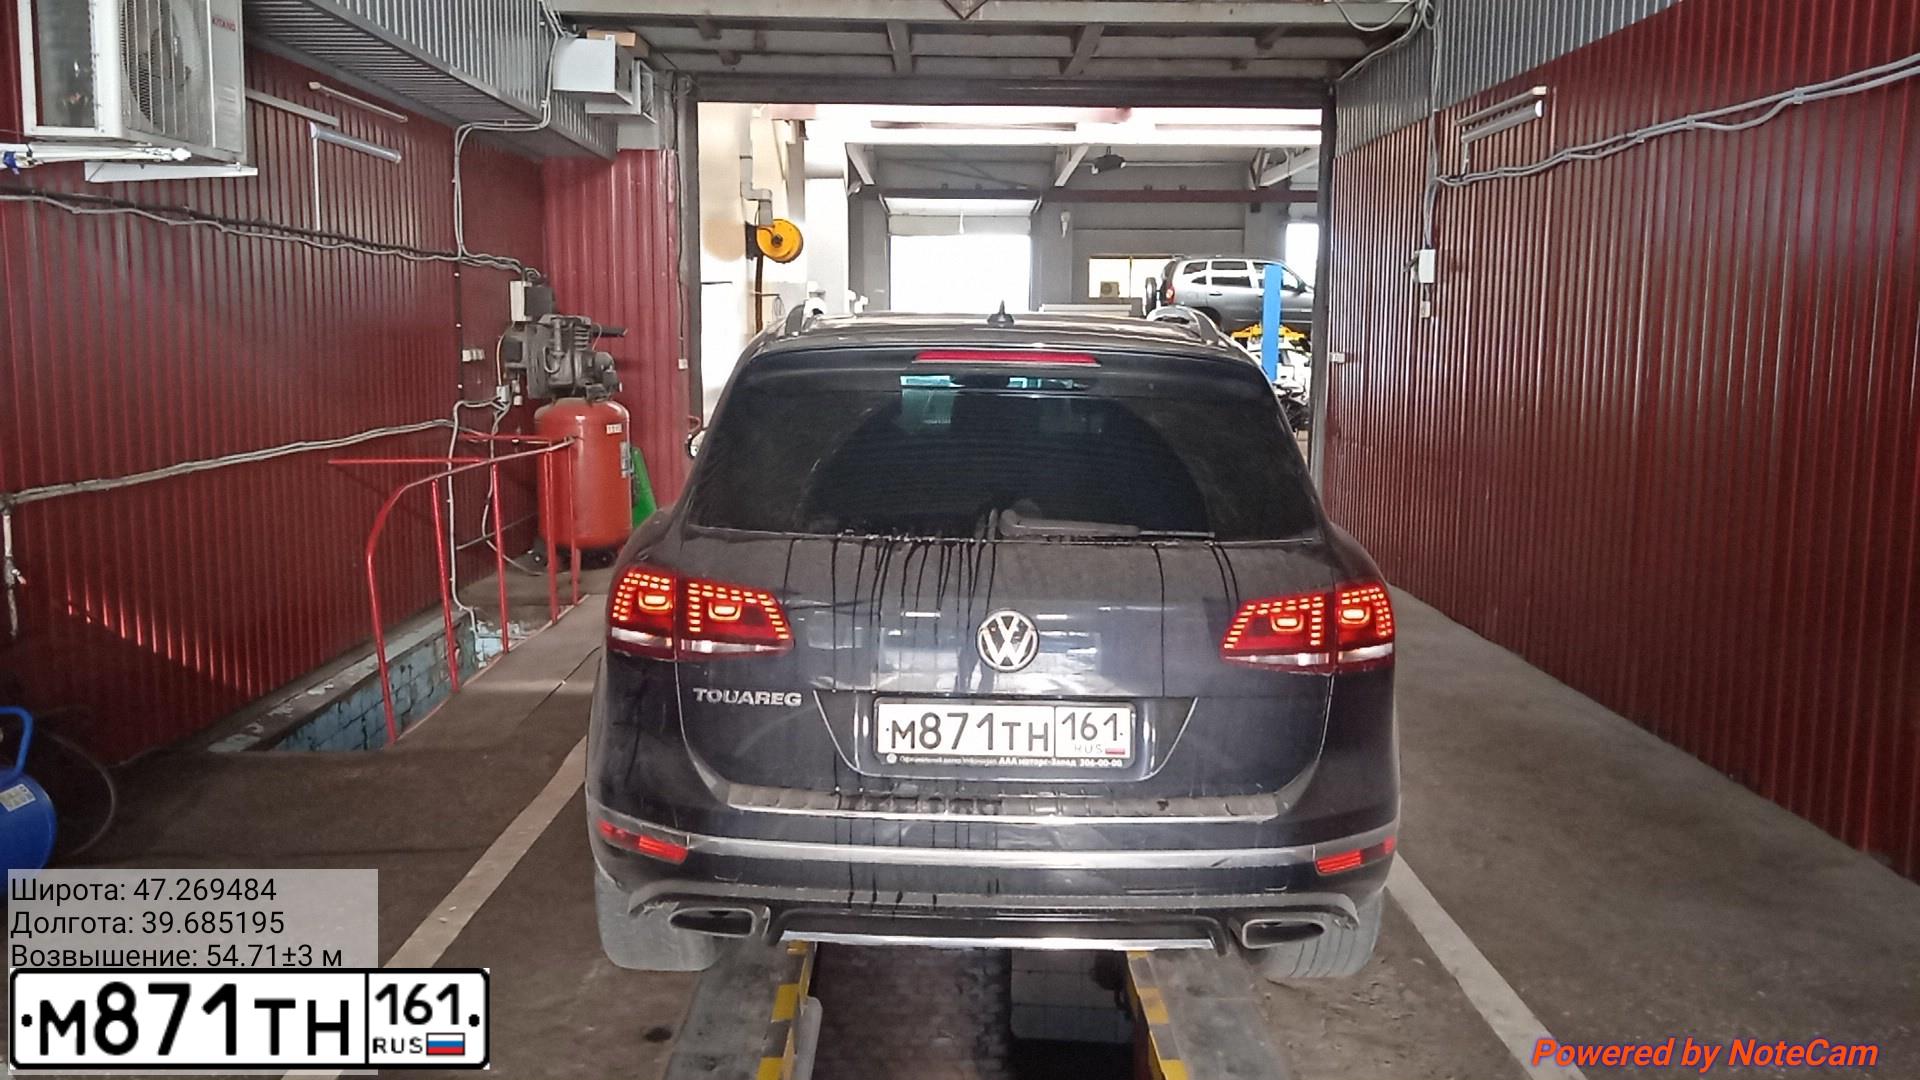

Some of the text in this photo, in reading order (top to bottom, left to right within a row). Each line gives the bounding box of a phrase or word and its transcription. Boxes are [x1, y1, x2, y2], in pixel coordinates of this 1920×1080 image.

[693, 688, 802, 706] TOUAREG
[891, 712, 1118, 751] М871ТН 161
[1074, 744, 1103, 754] RUS
